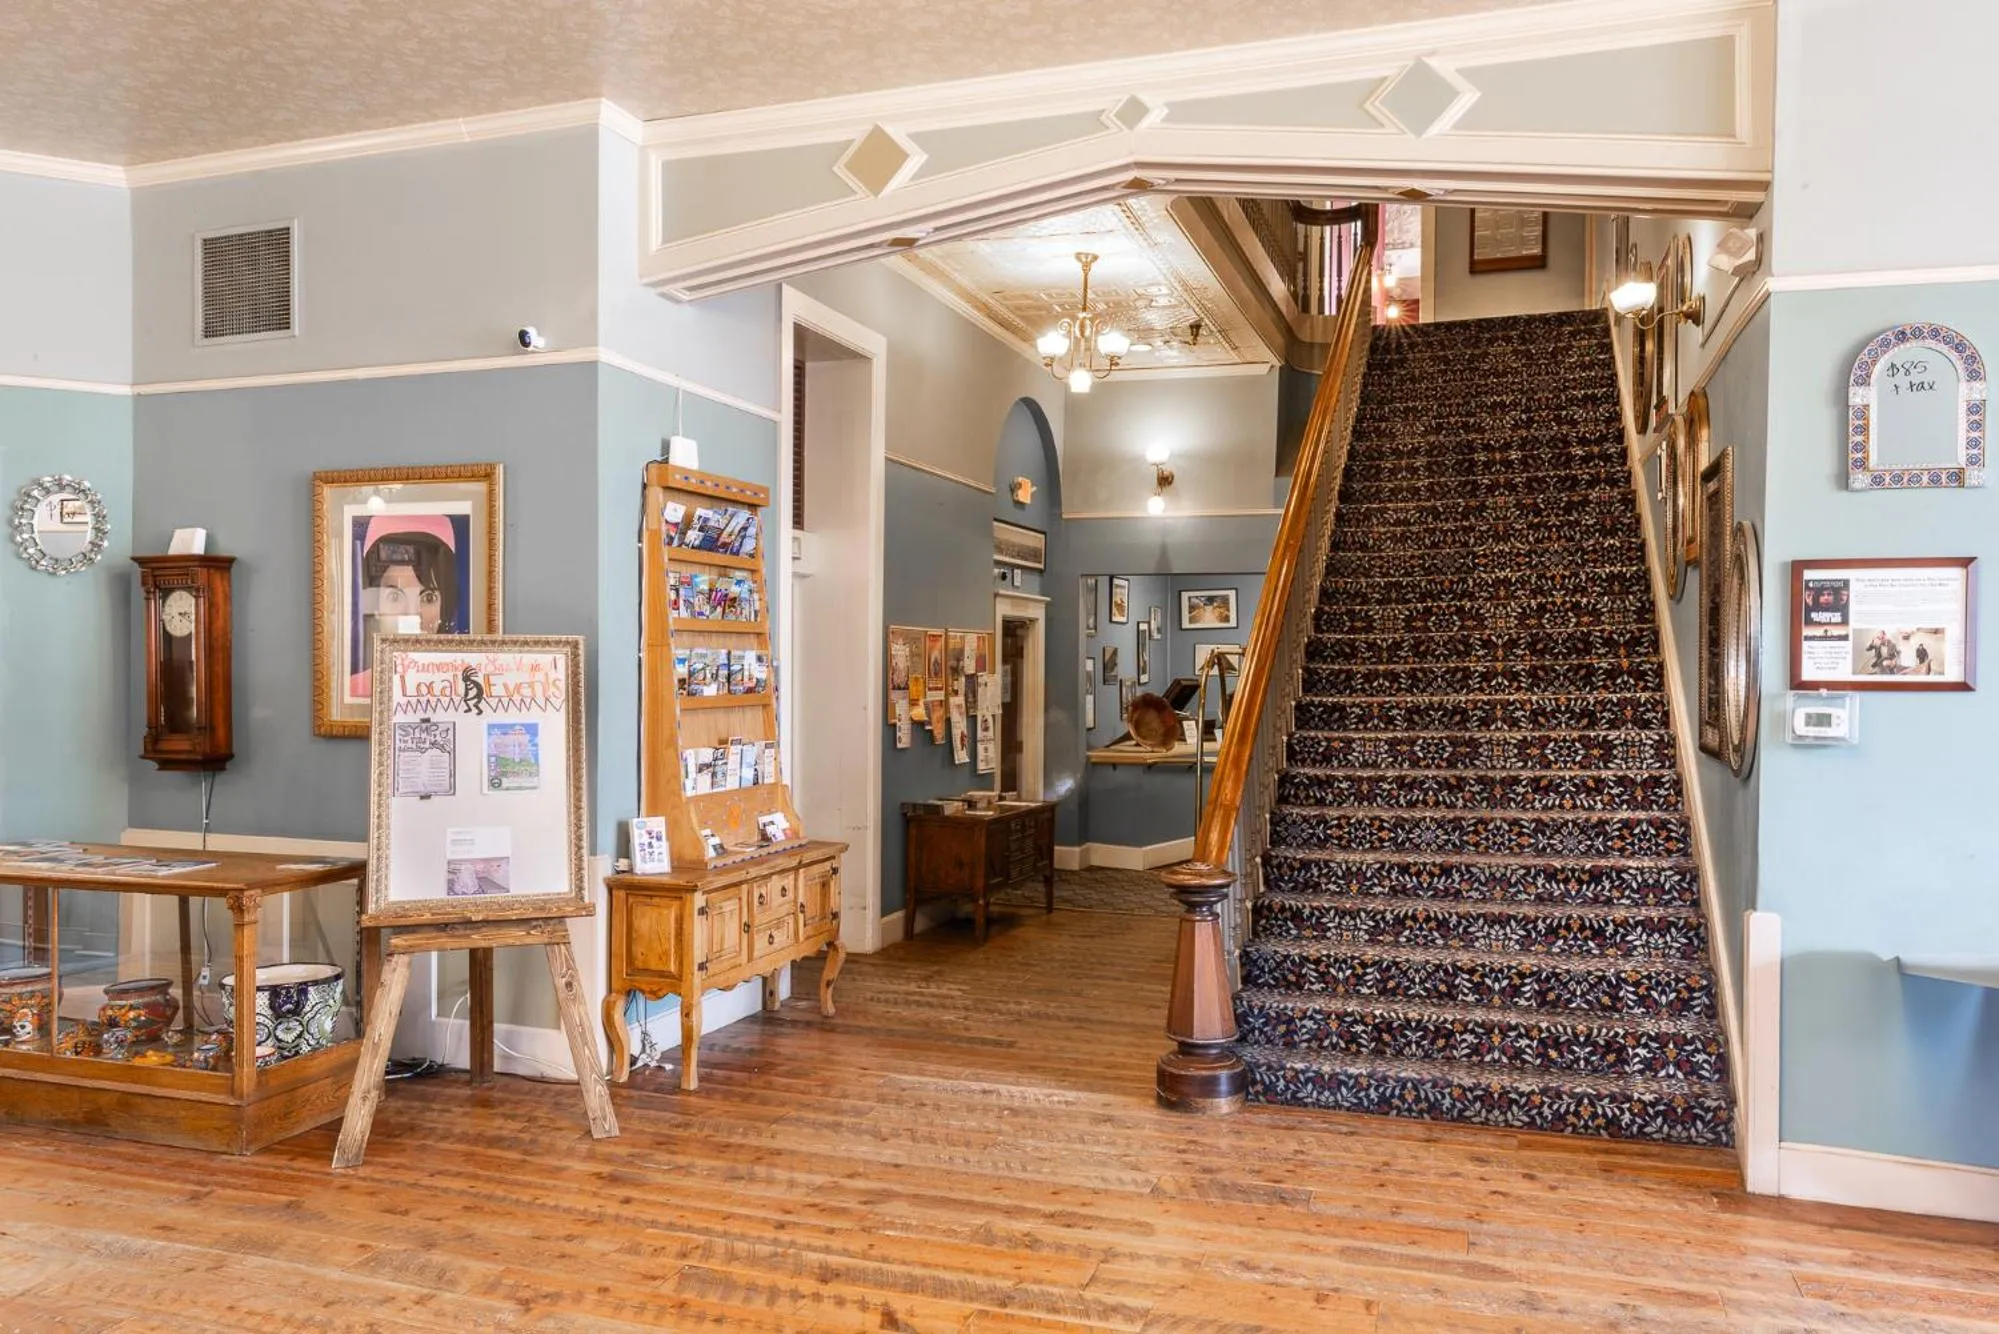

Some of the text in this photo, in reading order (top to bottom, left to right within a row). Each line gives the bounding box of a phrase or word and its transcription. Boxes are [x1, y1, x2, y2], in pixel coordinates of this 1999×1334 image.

[1886, 360, 1929, 378] $85
[1908, 379, 1937, 393] tax
[400, 672, 563, 699] Local Events
